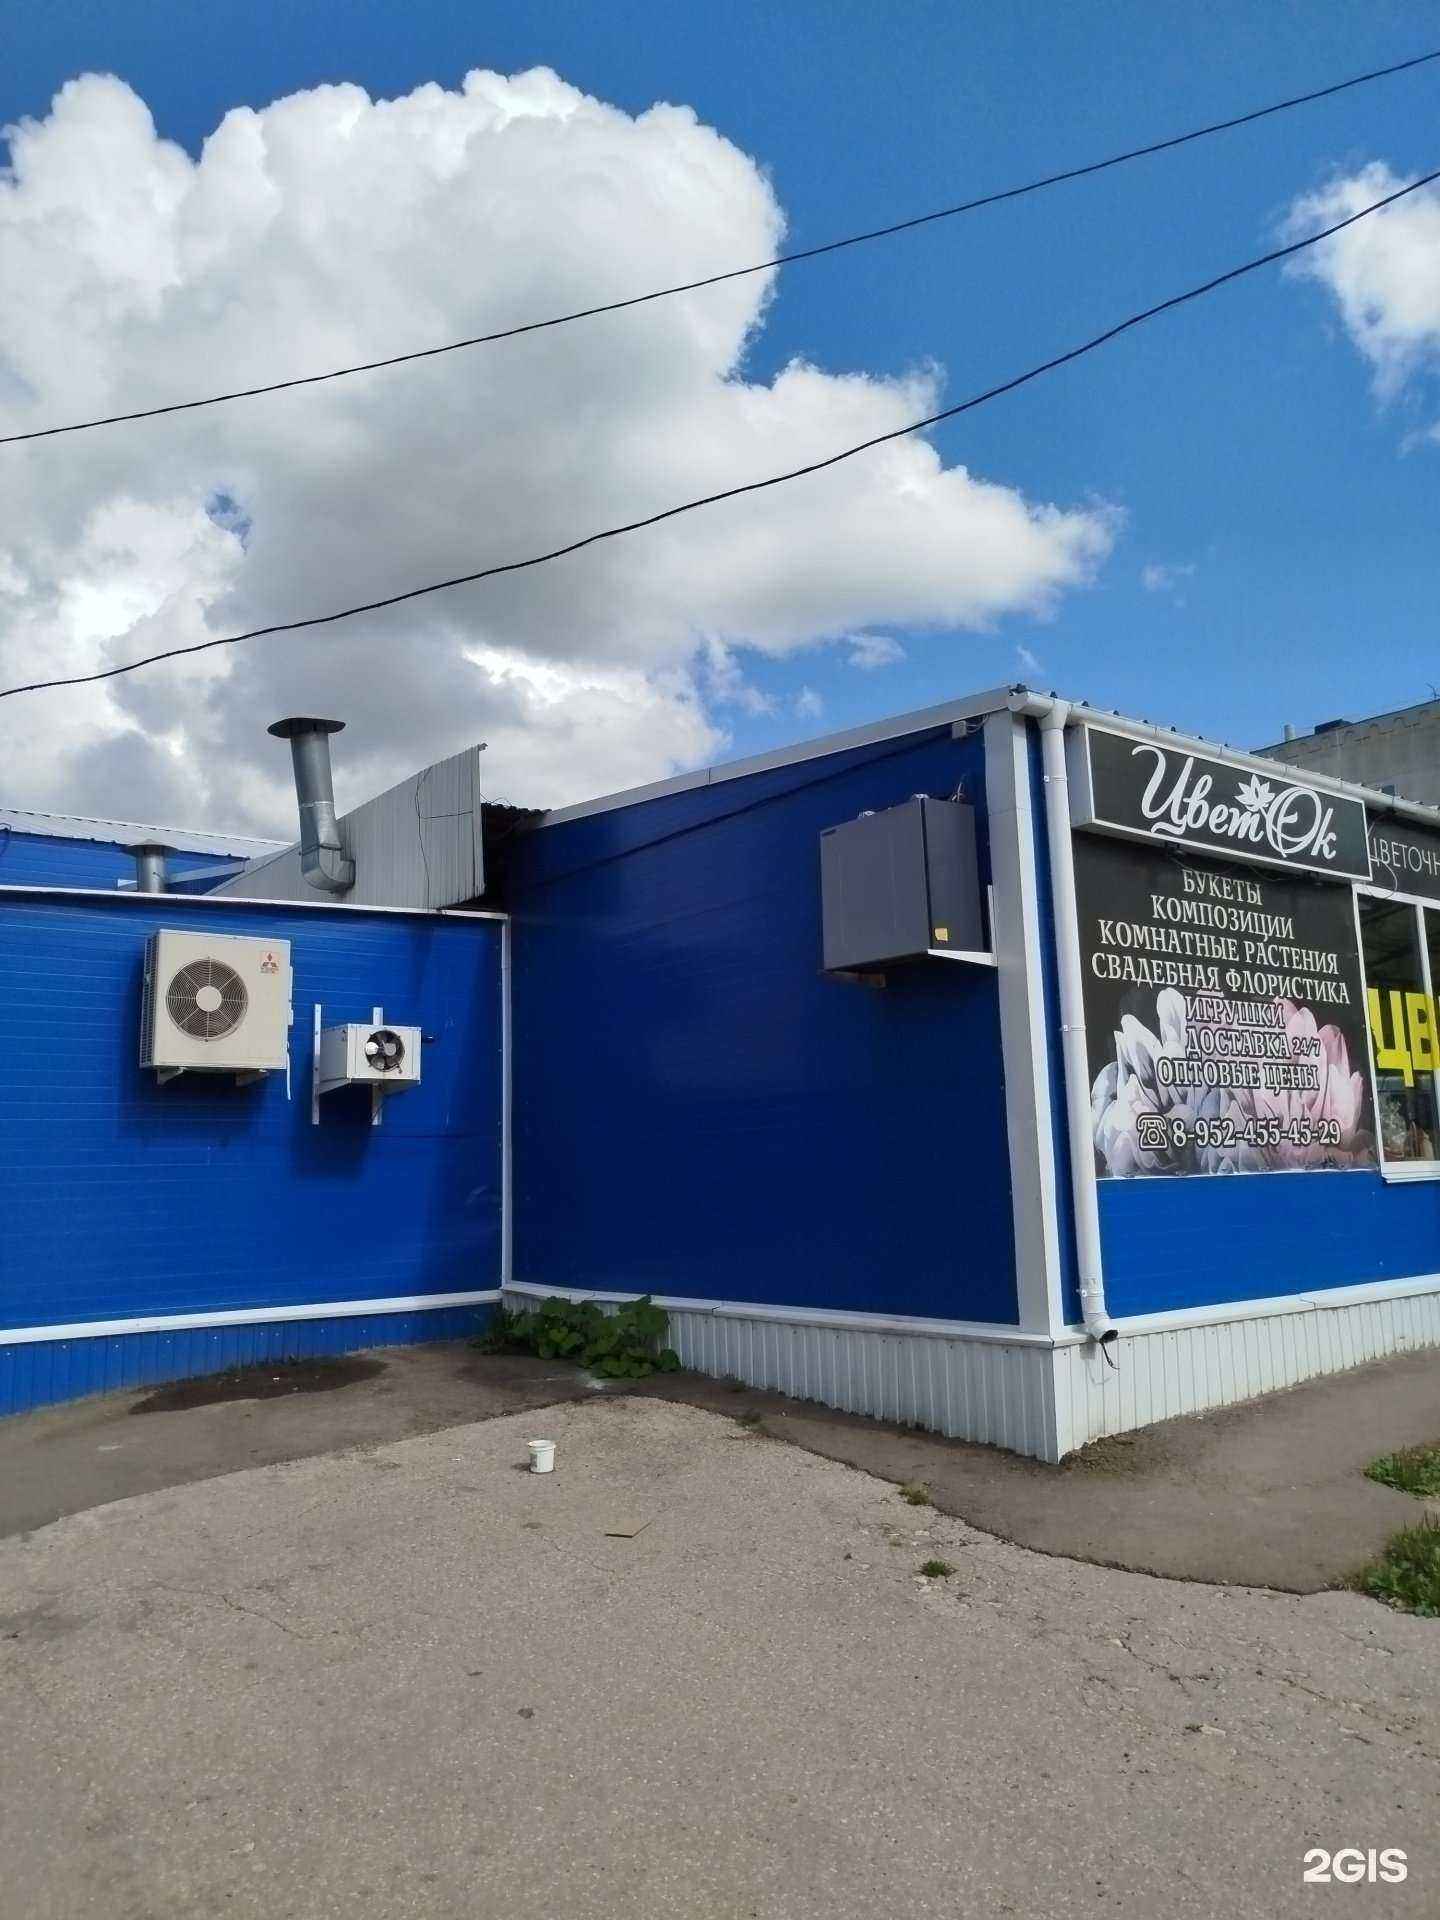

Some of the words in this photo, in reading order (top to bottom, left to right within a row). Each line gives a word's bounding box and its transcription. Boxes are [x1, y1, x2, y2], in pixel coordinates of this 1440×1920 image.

[1182, 869, 1263, 906] БУКЕТЫ
[1150, 895, 1295, 941] КОМПОЗИЦИИ
[1098, 919, 1240, 962] КОМНАТНЫЕ
[1243, 940, 1340, 975] РАСТЕНИЯ
[1091, 952, 1222, 990] СВАДЕБНАЯ
[1226, 967, 1350, 1004] ФЛОРИСТИКА
[1185, 996, 1286, 1028] ИГРУШКИ
[1186, 1026, 1291, 1060] ДОСТАВКА
[1292, 1037, 1321, 1057] 24/7
[1157, 1057, 1260, 1089] ОПТОВЫЕ
[1264, 1063, 1320, 1095] ЦЕНЫ
[1173, 1118, 1342, 1147] 8-952-455-45-29
